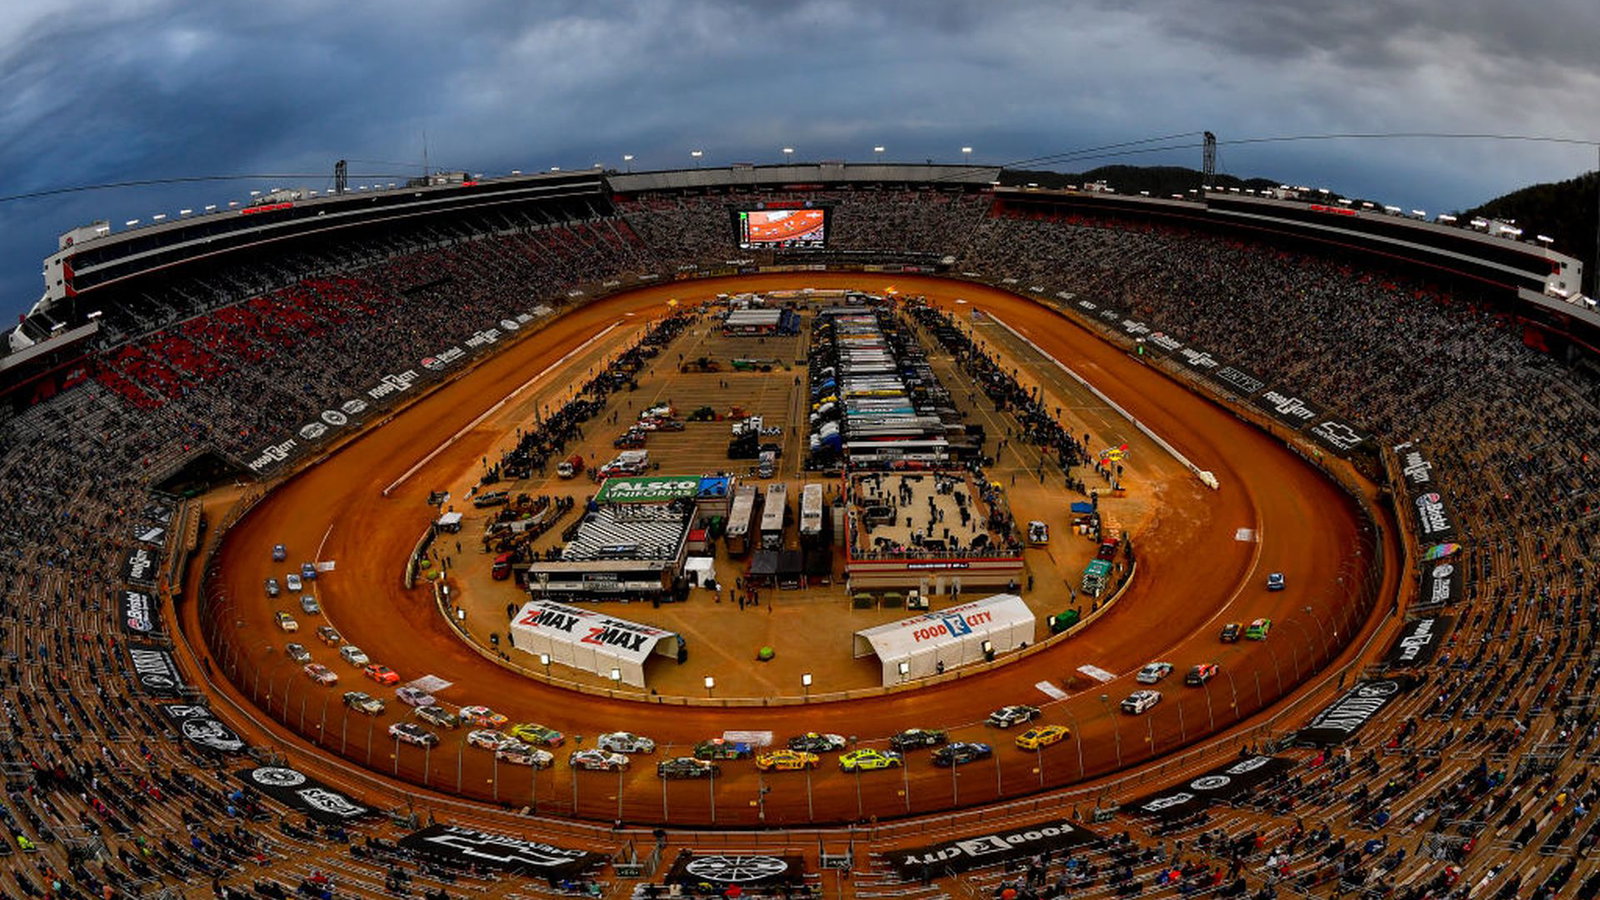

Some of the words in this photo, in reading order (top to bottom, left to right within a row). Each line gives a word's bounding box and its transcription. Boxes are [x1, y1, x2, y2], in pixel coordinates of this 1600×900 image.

[367, 381, 397, 399] FOOD
[400, 369, 420, 386] CITY
[1262, 391, 1287, 408] FOOD
[1293, 405, 1316, 419] CITY
[249, 452, 276, 472] FOOD
[280, 438, 297, 455] CITY
[604, 490, 694, 500] UNIFORMS
[609, 480, 697, 492] ALSCO
[1426, 502, 1452, 532] Bristol
[127, 592, 141, 622] Bristol
[519, 609, 580, 633] ZMAX
[913, 624, 948, 643] FOOD
[966, 611, 992, 627] CITY
[580, 627, 648, 652] ZMAX
[1009, 822, 1075, 845] FOOD
[904, 846, 960, 865] CITY
